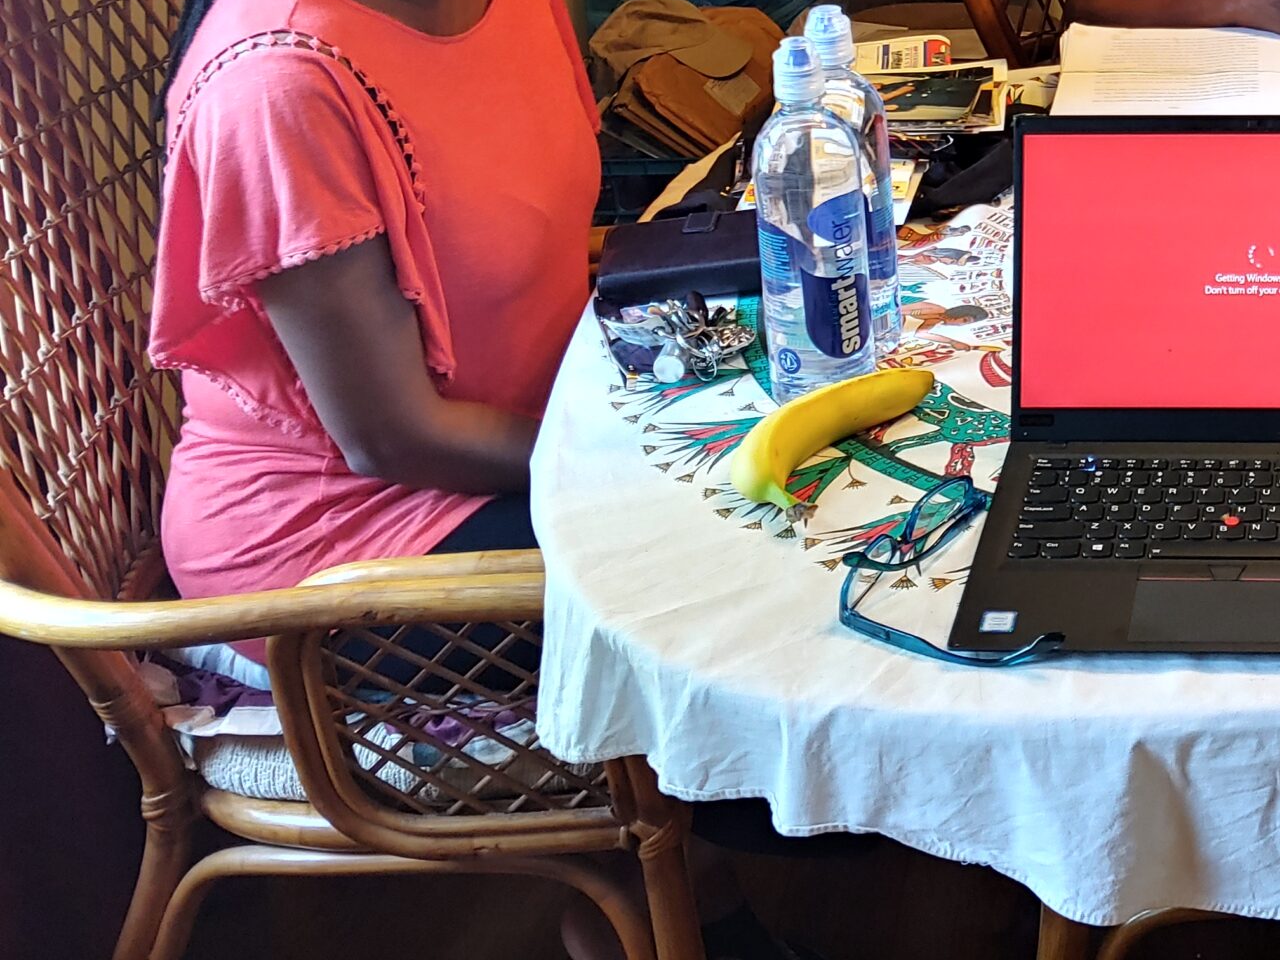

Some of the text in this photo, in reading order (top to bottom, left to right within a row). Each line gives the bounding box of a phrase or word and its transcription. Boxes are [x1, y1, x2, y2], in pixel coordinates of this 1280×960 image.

[1215, 274, 1245, 284] Getting
[831, 217, 861, 354] smartwater
[1204, 286, 1227, 294] Don't
[1246, 286, 1258, 294] off
[1259, 288, 1278, 296] your
